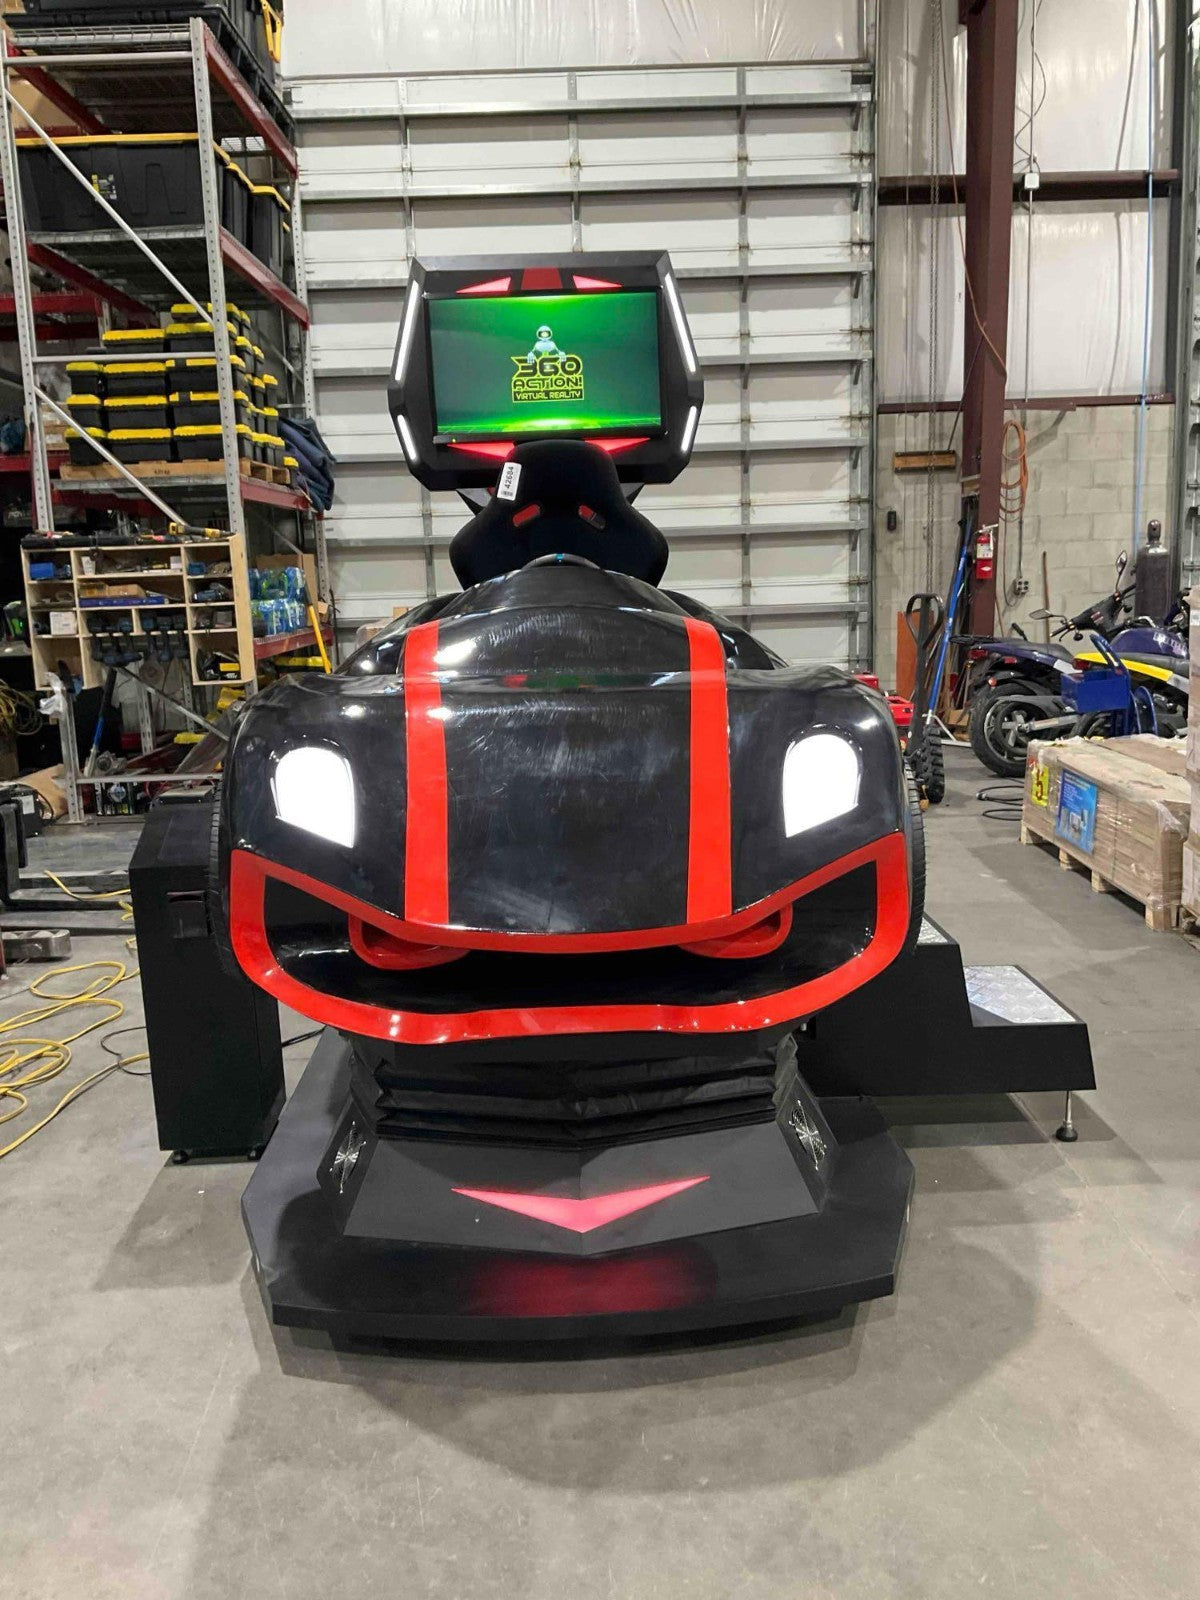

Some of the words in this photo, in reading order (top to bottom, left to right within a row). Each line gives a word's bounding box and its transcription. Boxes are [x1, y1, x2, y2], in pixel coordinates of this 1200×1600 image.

[512, 355, 582, 377] 360
[512, 377, 582, 389] ACTION!
[515, 391, 548, 400] VIRTUAL
[549, 390, 581, 399] REALITY
